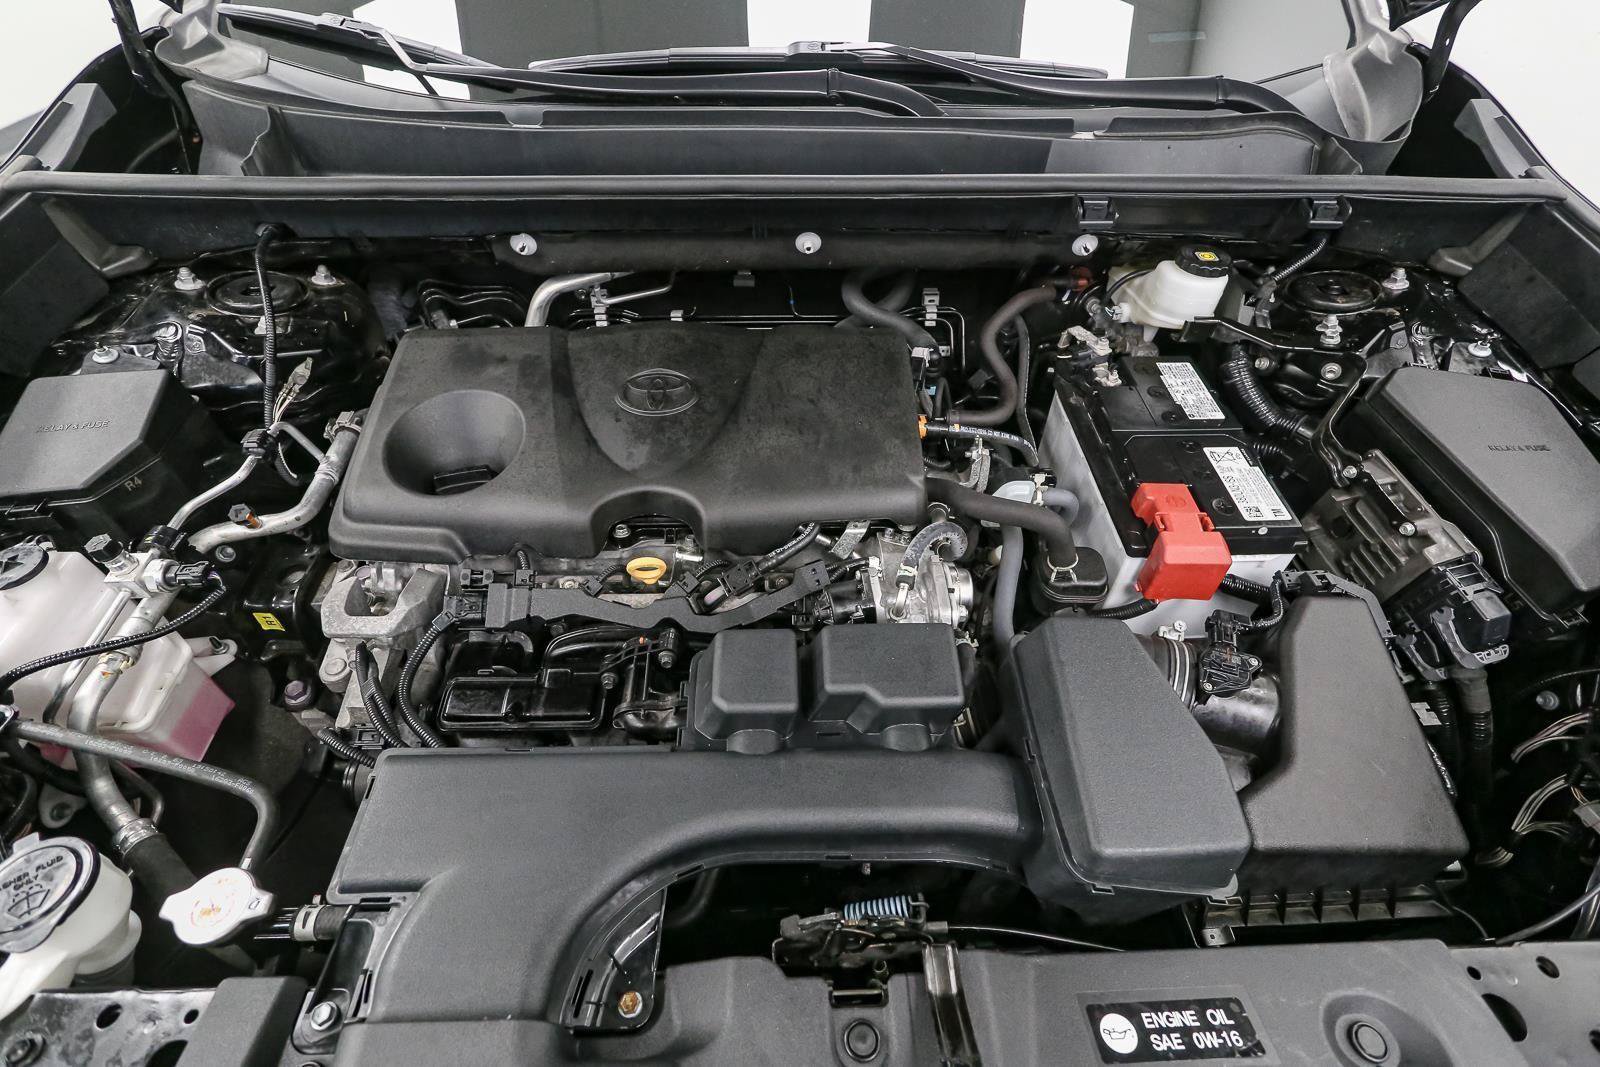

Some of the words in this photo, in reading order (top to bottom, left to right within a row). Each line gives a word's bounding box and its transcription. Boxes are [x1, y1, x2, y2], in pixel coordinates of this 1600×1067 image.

[36, 424, 72, 433] RELAY
[81, 420, 111, 430] FUSE
[124, 476, 142, 491] R4
[0, 872, 29, 891] SHER
[35, 855, 64, 872] FLUID
[14, 874, 39, 890] ONLY
[1141, 1010, 1200, 1028] ENGINE
[1206, 1009, 1235, 1026] OIL
[1150, 1033, 1186, 1051] SAE
[1192, 1030, 1244, 1050] 0W-16
